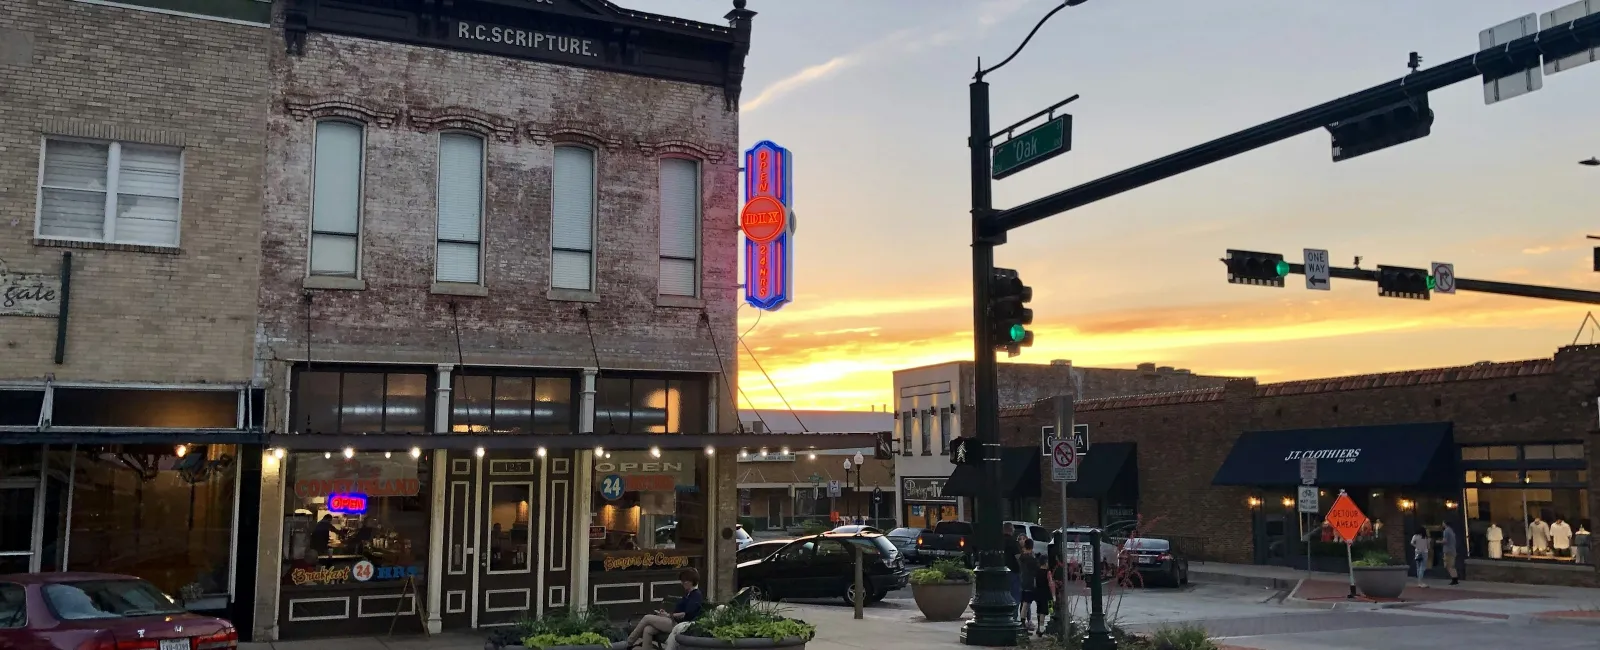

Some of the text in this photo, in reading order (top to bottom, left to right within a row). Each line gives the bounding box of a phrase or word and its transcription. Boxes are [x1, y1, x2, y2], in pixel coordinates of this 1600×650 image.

[1016, 136, 1037, 161] Oak
[759, 151, 768, 192] OPEN
[745, 211, 779, 225] DIX
[1307, 252, 1325, 262] ONE
[1309, 263, 1325, 273] WAY
[1285, 449, 1361, 461] J.T. CLOTHIERS
[595, 462, 682, 472] OPEN
[295, 480, 353, 498] CONEY
[603, 477, 621, 497] 24
[331, 496, 364, 510] OPEN
[1333, 510, 1360, 518] DETOUR
[1336, 520, 1359, 528] AHEAD
[291, 565, 350, 585] Breakfast
[356, 564, 371, 578] 24
